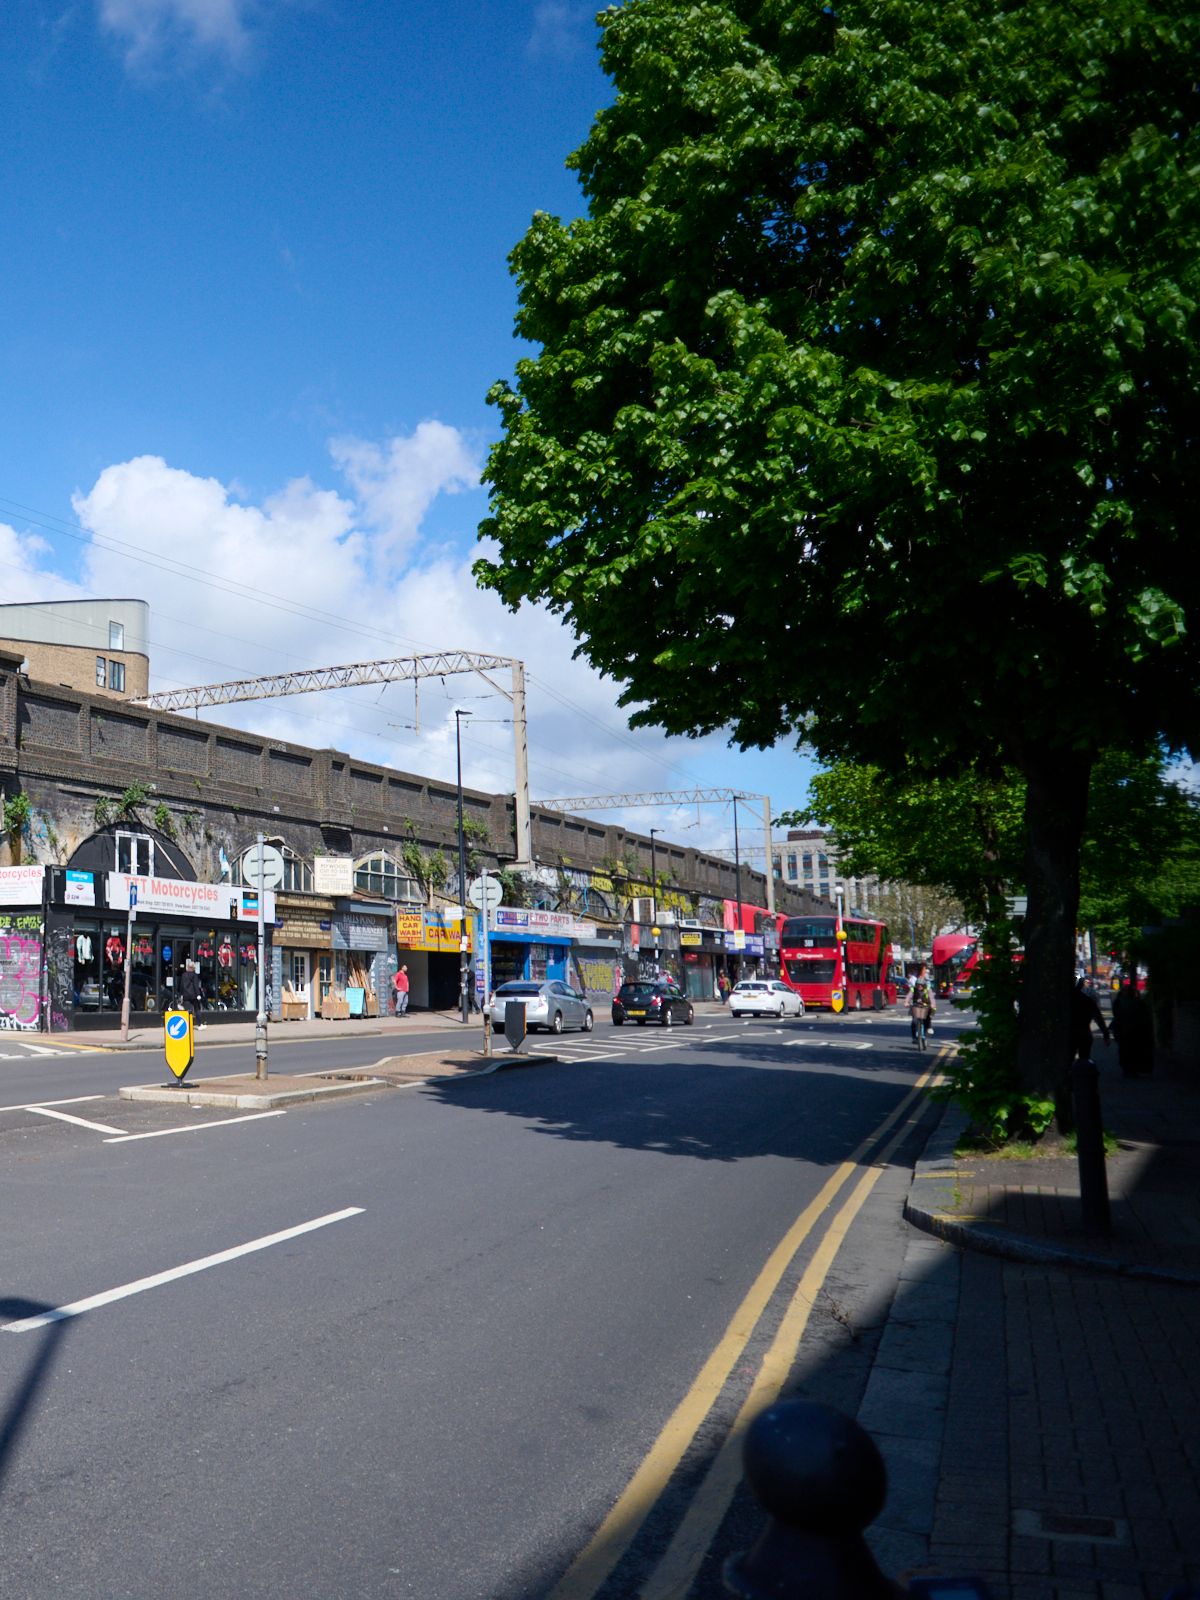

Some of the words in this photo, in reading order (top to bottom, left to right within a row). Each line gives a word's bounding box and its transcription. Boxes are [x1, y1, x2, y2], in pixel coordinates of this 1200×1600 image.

[151, 879, 218, 904] Motorcycles
[551, 914, 570, 925] PARTS
[428, 928, 447, 940] CAR
[449, 930, 471, 940] WAH
